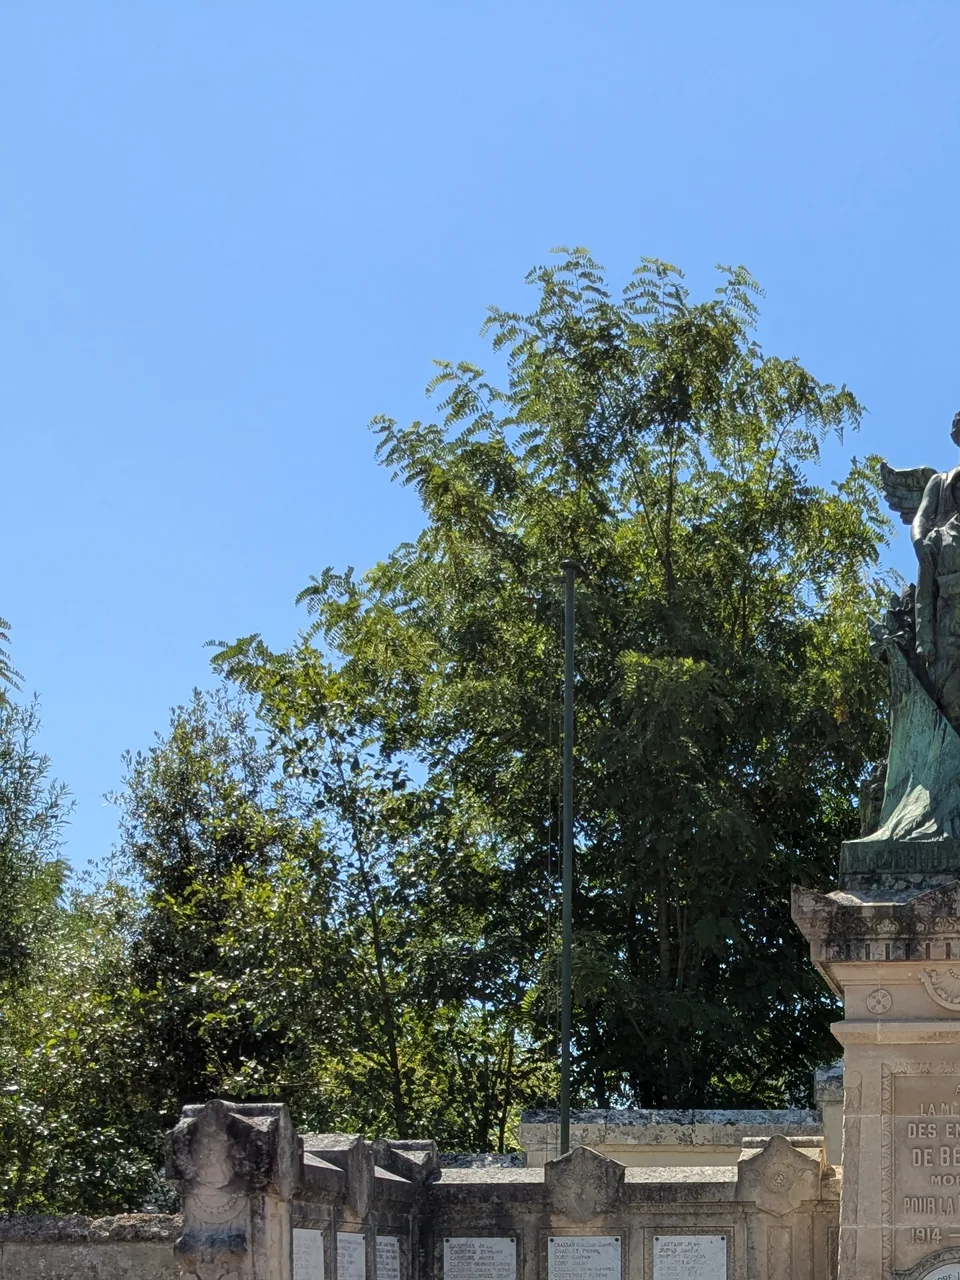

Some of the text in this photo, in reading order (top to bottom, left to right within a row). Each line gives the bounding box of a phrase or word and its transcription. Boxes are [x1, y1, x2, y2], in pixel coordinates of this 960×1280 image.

[920, 1103, 937, 1116] LA
[907, 1123, 938, 1138] DES
[912, 1148, 934, 1167] DE
[903, 1196, 937, 1215] POUR
[940, 1197, 955, 1215] LA
[911, 1227, 943, 1245] 1914
